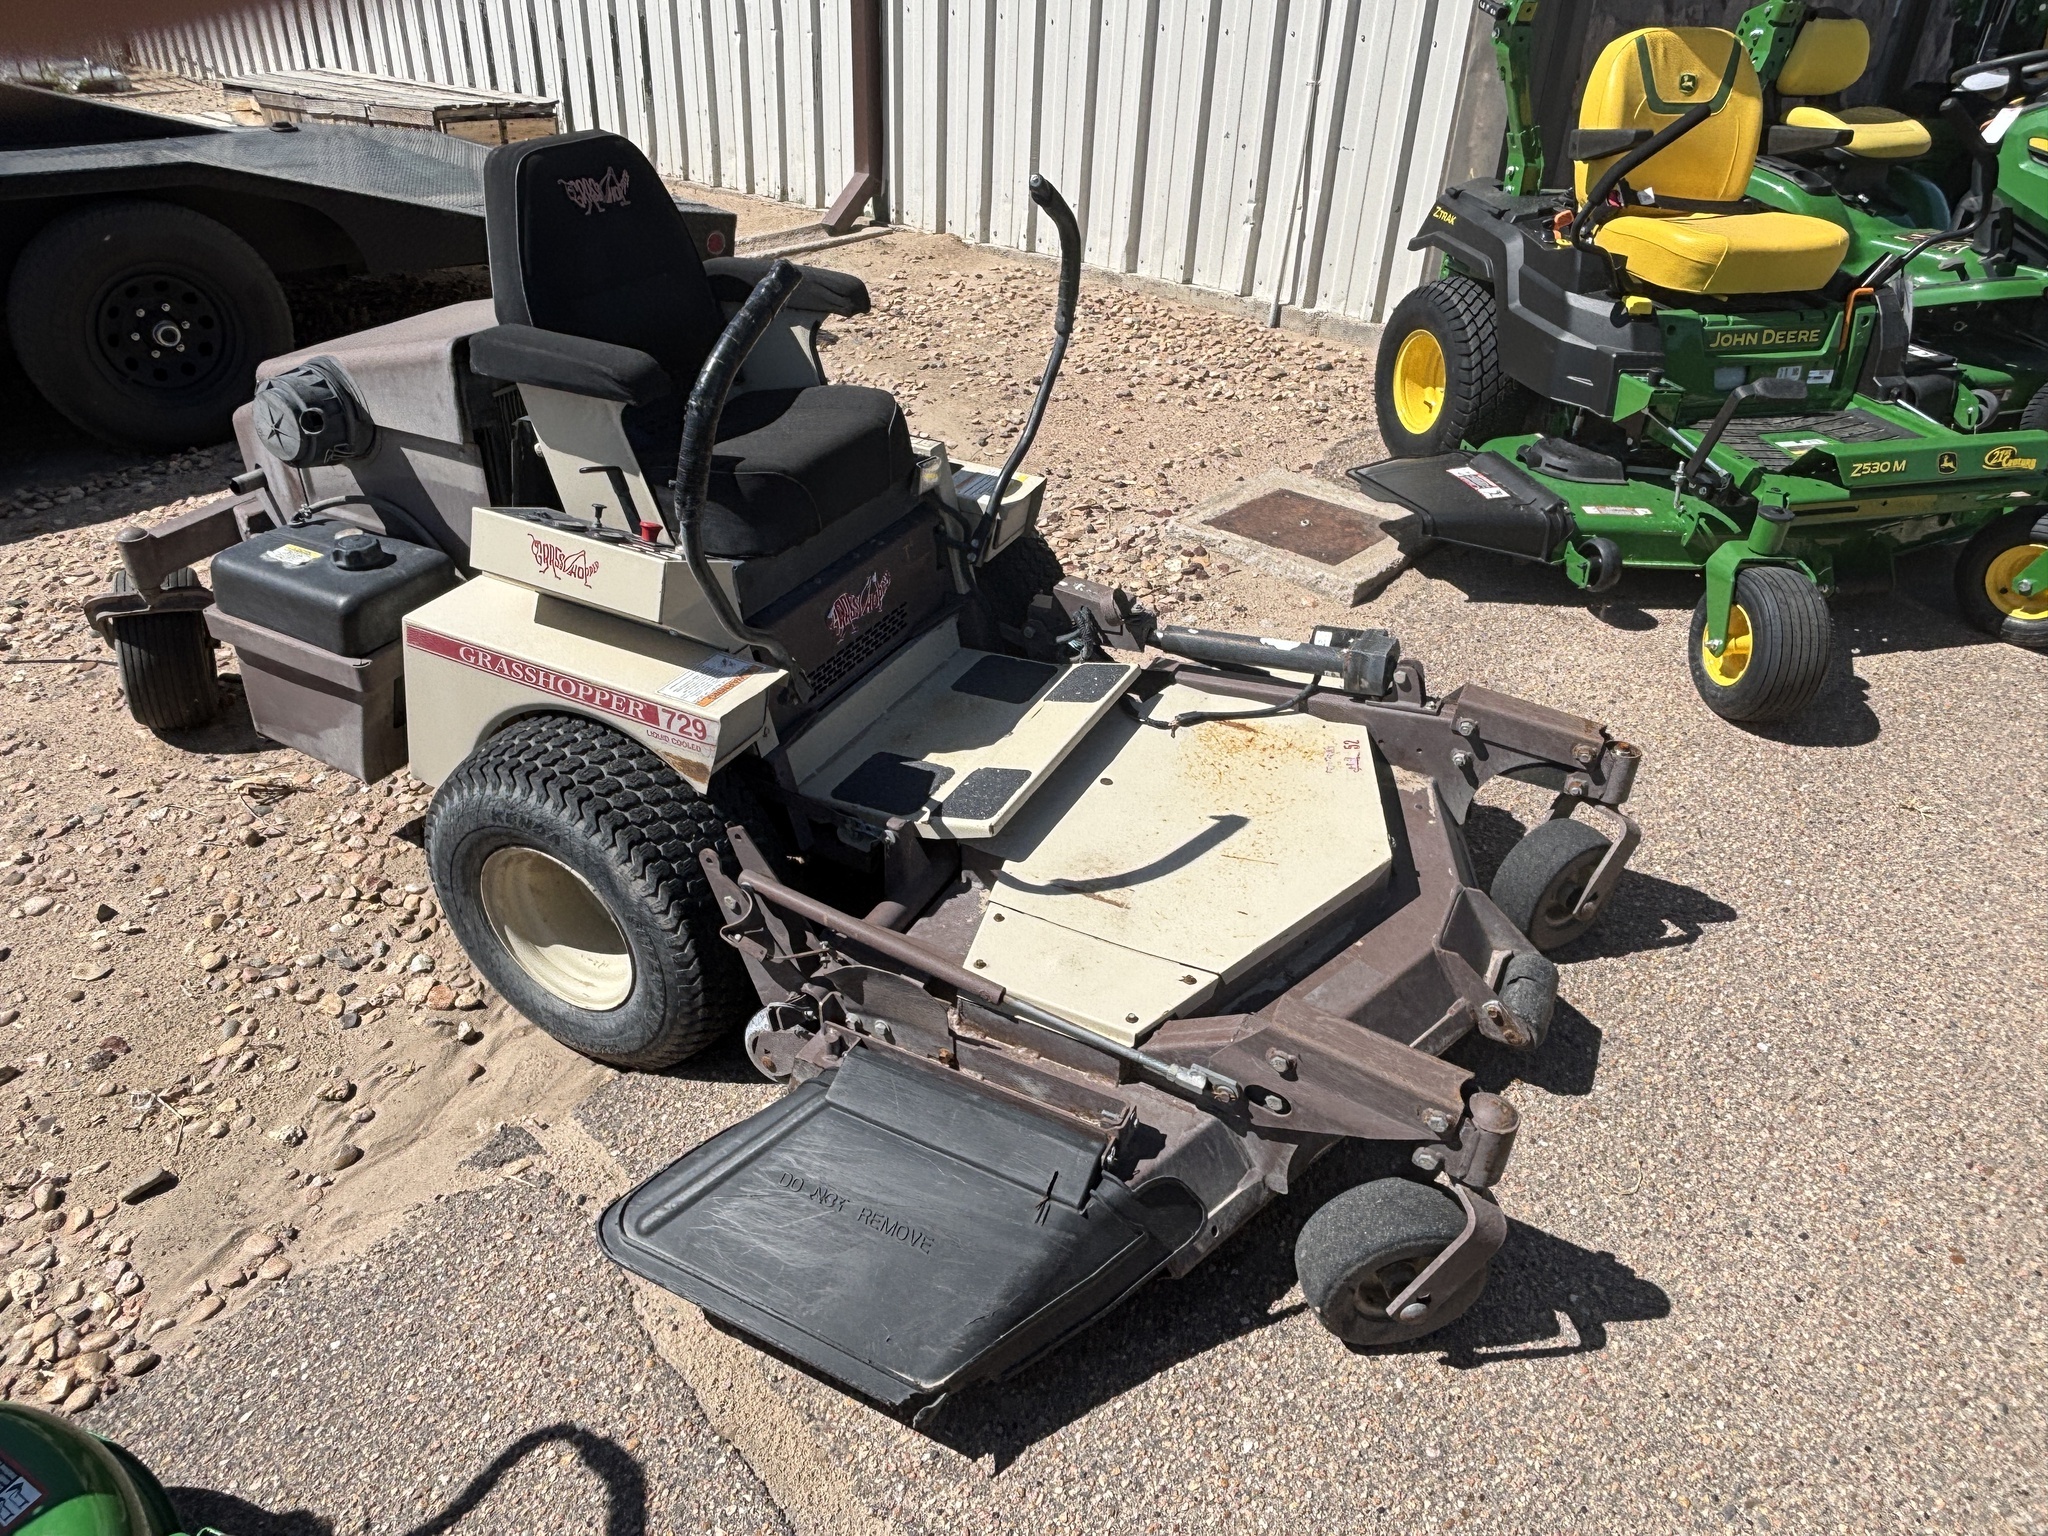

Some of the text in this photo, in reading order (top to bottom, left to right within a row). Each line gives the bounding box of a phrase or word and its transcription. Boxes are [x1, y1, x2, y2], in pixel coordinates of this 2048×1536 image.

[1432, 206, 1457, 226] ZTRAK
[1710, 329, 1821, 348] JOHN DEERE
[1850, 460, 1907, 477] Z530 M
[459, 646, 645, 720] GRASSHOPPER
[662, 708, 707, 741] 729
[646, 729, 701, 753] LIQUID COOLED
[779, 1172, 935, 1255] DO NOT REMOVE
